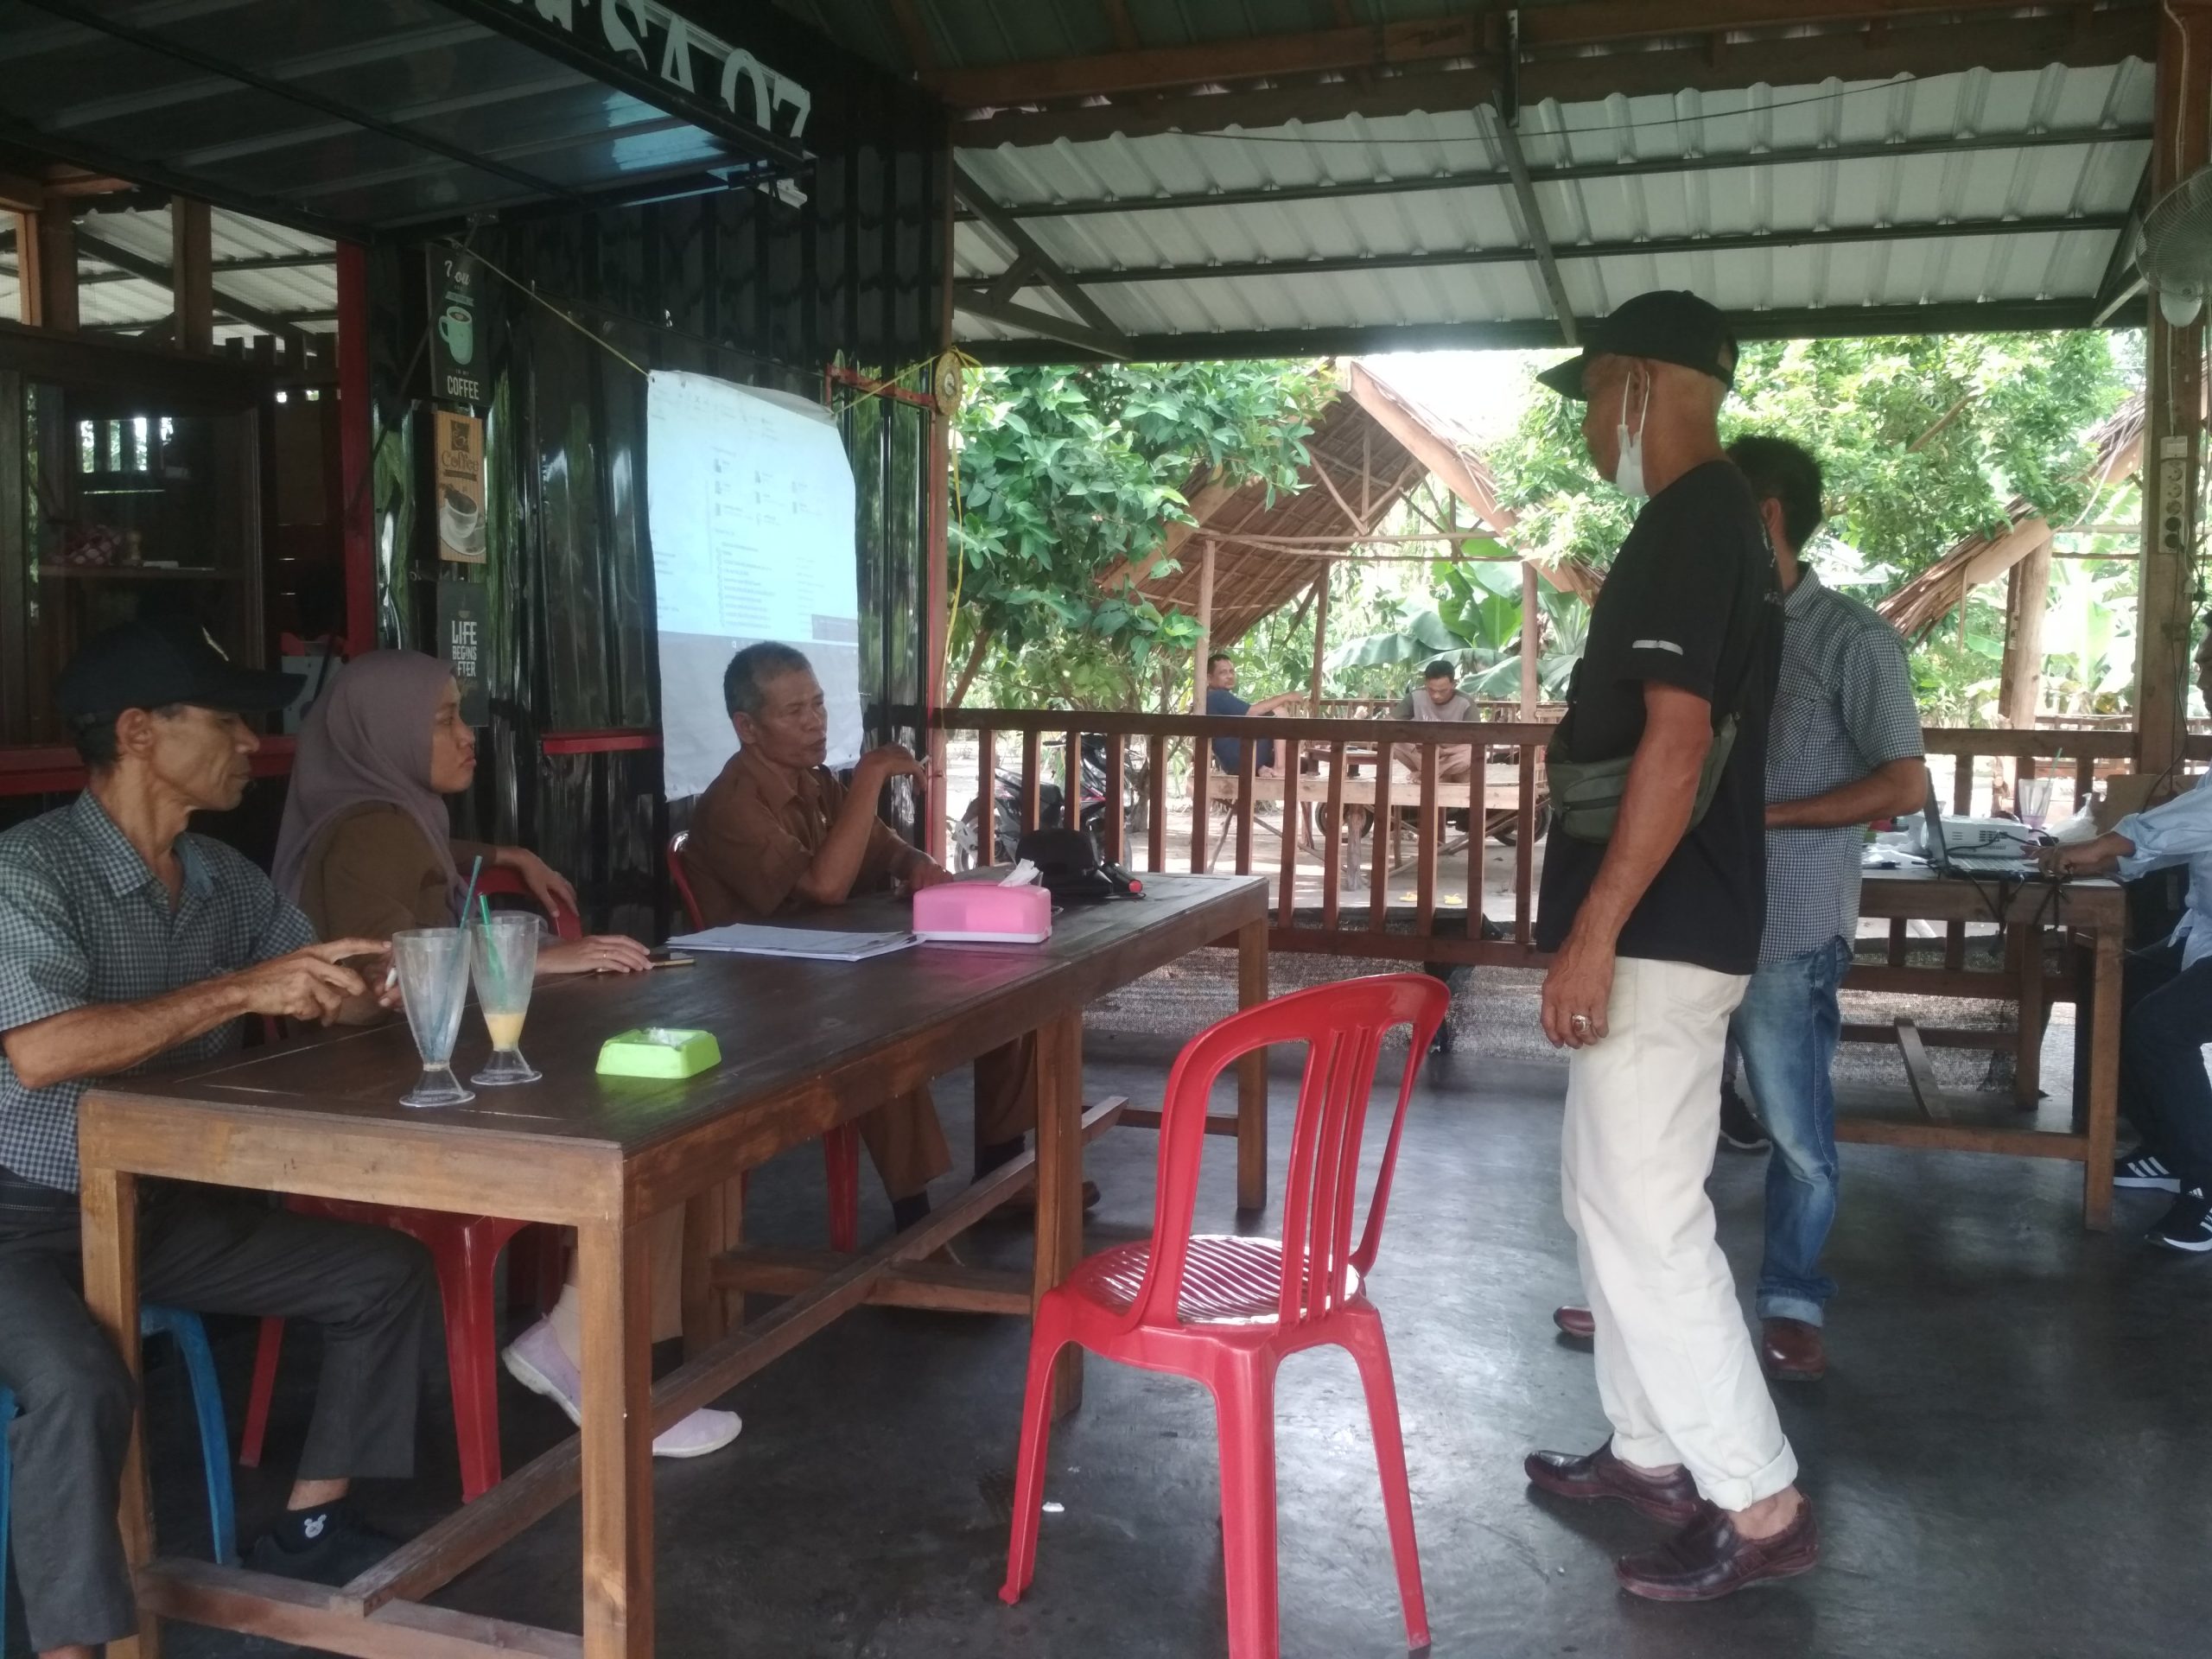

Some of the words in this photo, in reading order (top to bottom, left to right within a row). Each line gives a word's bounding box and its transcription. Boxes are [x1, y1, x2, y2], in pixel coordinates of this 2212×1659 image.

[447, 375, 480, 401] COFFEE
[442, 449, 480, 472] Coffee
[451, 620, 478, 645] LIFE
[452, 645, 478, 662] BEGINS
[457, 660, 477, 677] FTER
